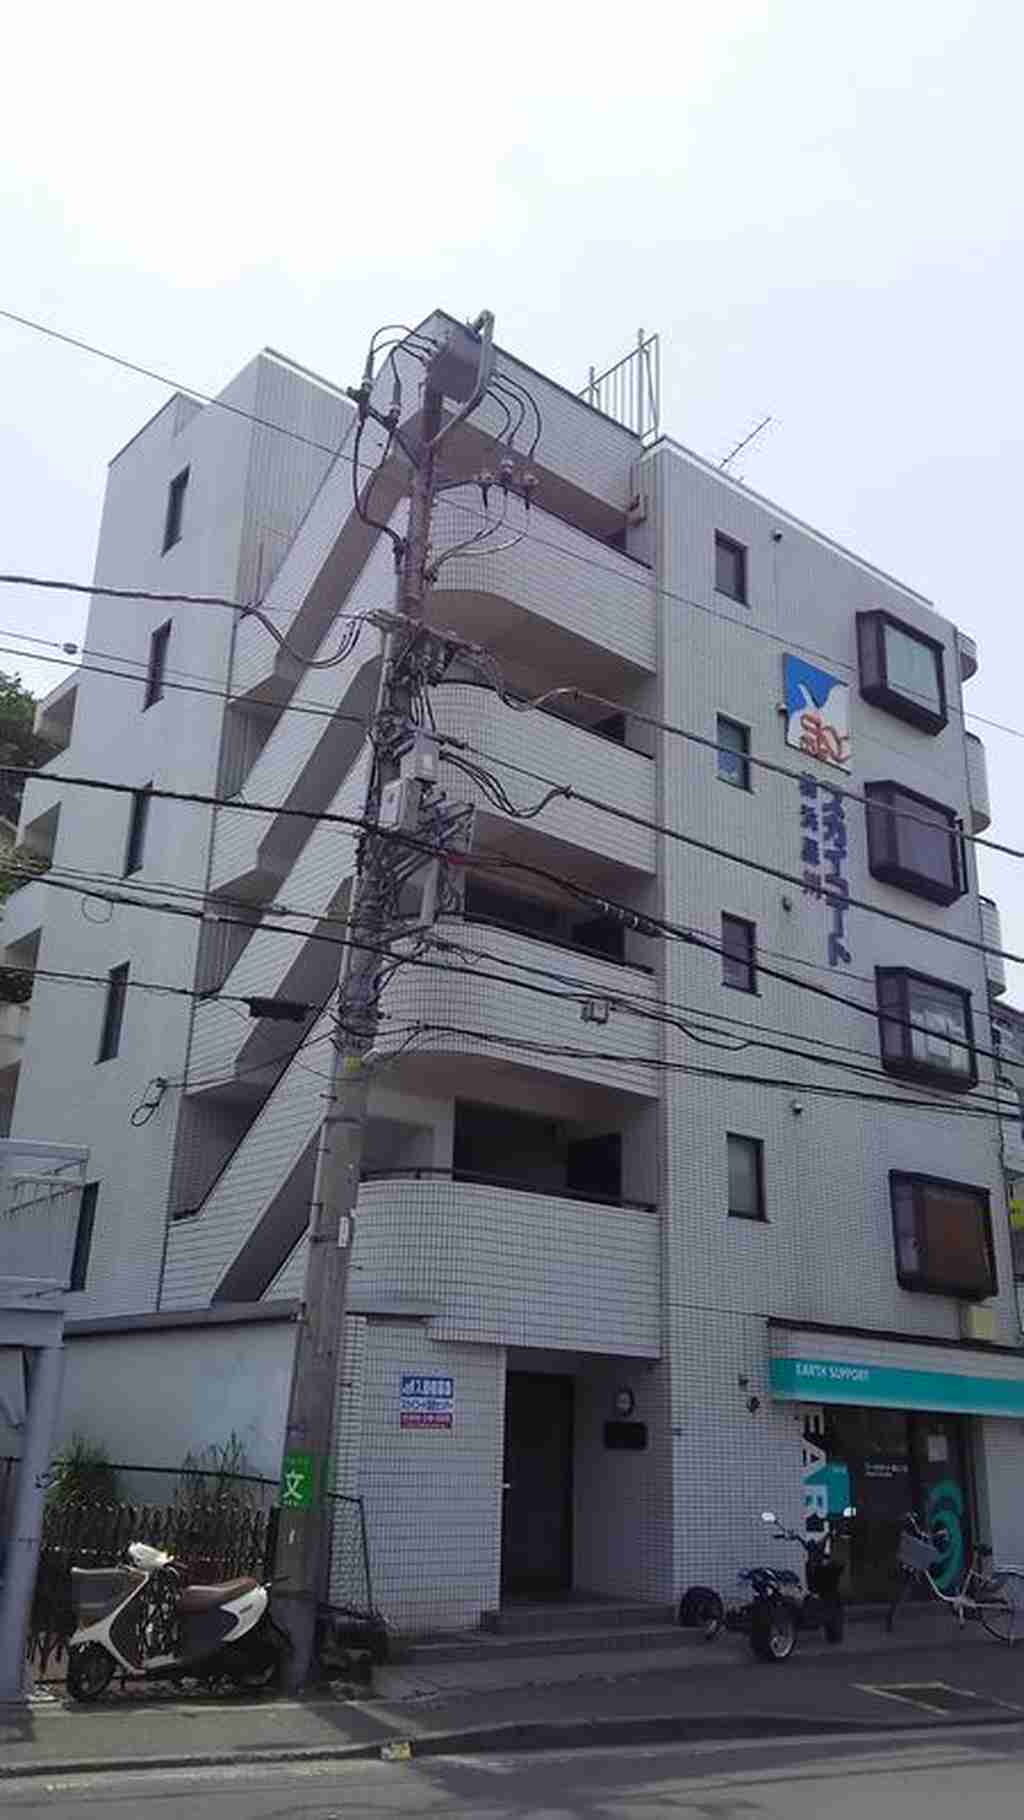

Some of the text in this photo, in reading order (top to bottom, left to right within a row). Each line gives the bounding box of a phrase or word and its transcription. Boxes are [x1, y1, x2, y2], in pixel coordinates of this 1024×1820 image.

[795, 1363, 871, 1381] EARTH SUPPORT
[282, 1470, 305, 1500] 文
